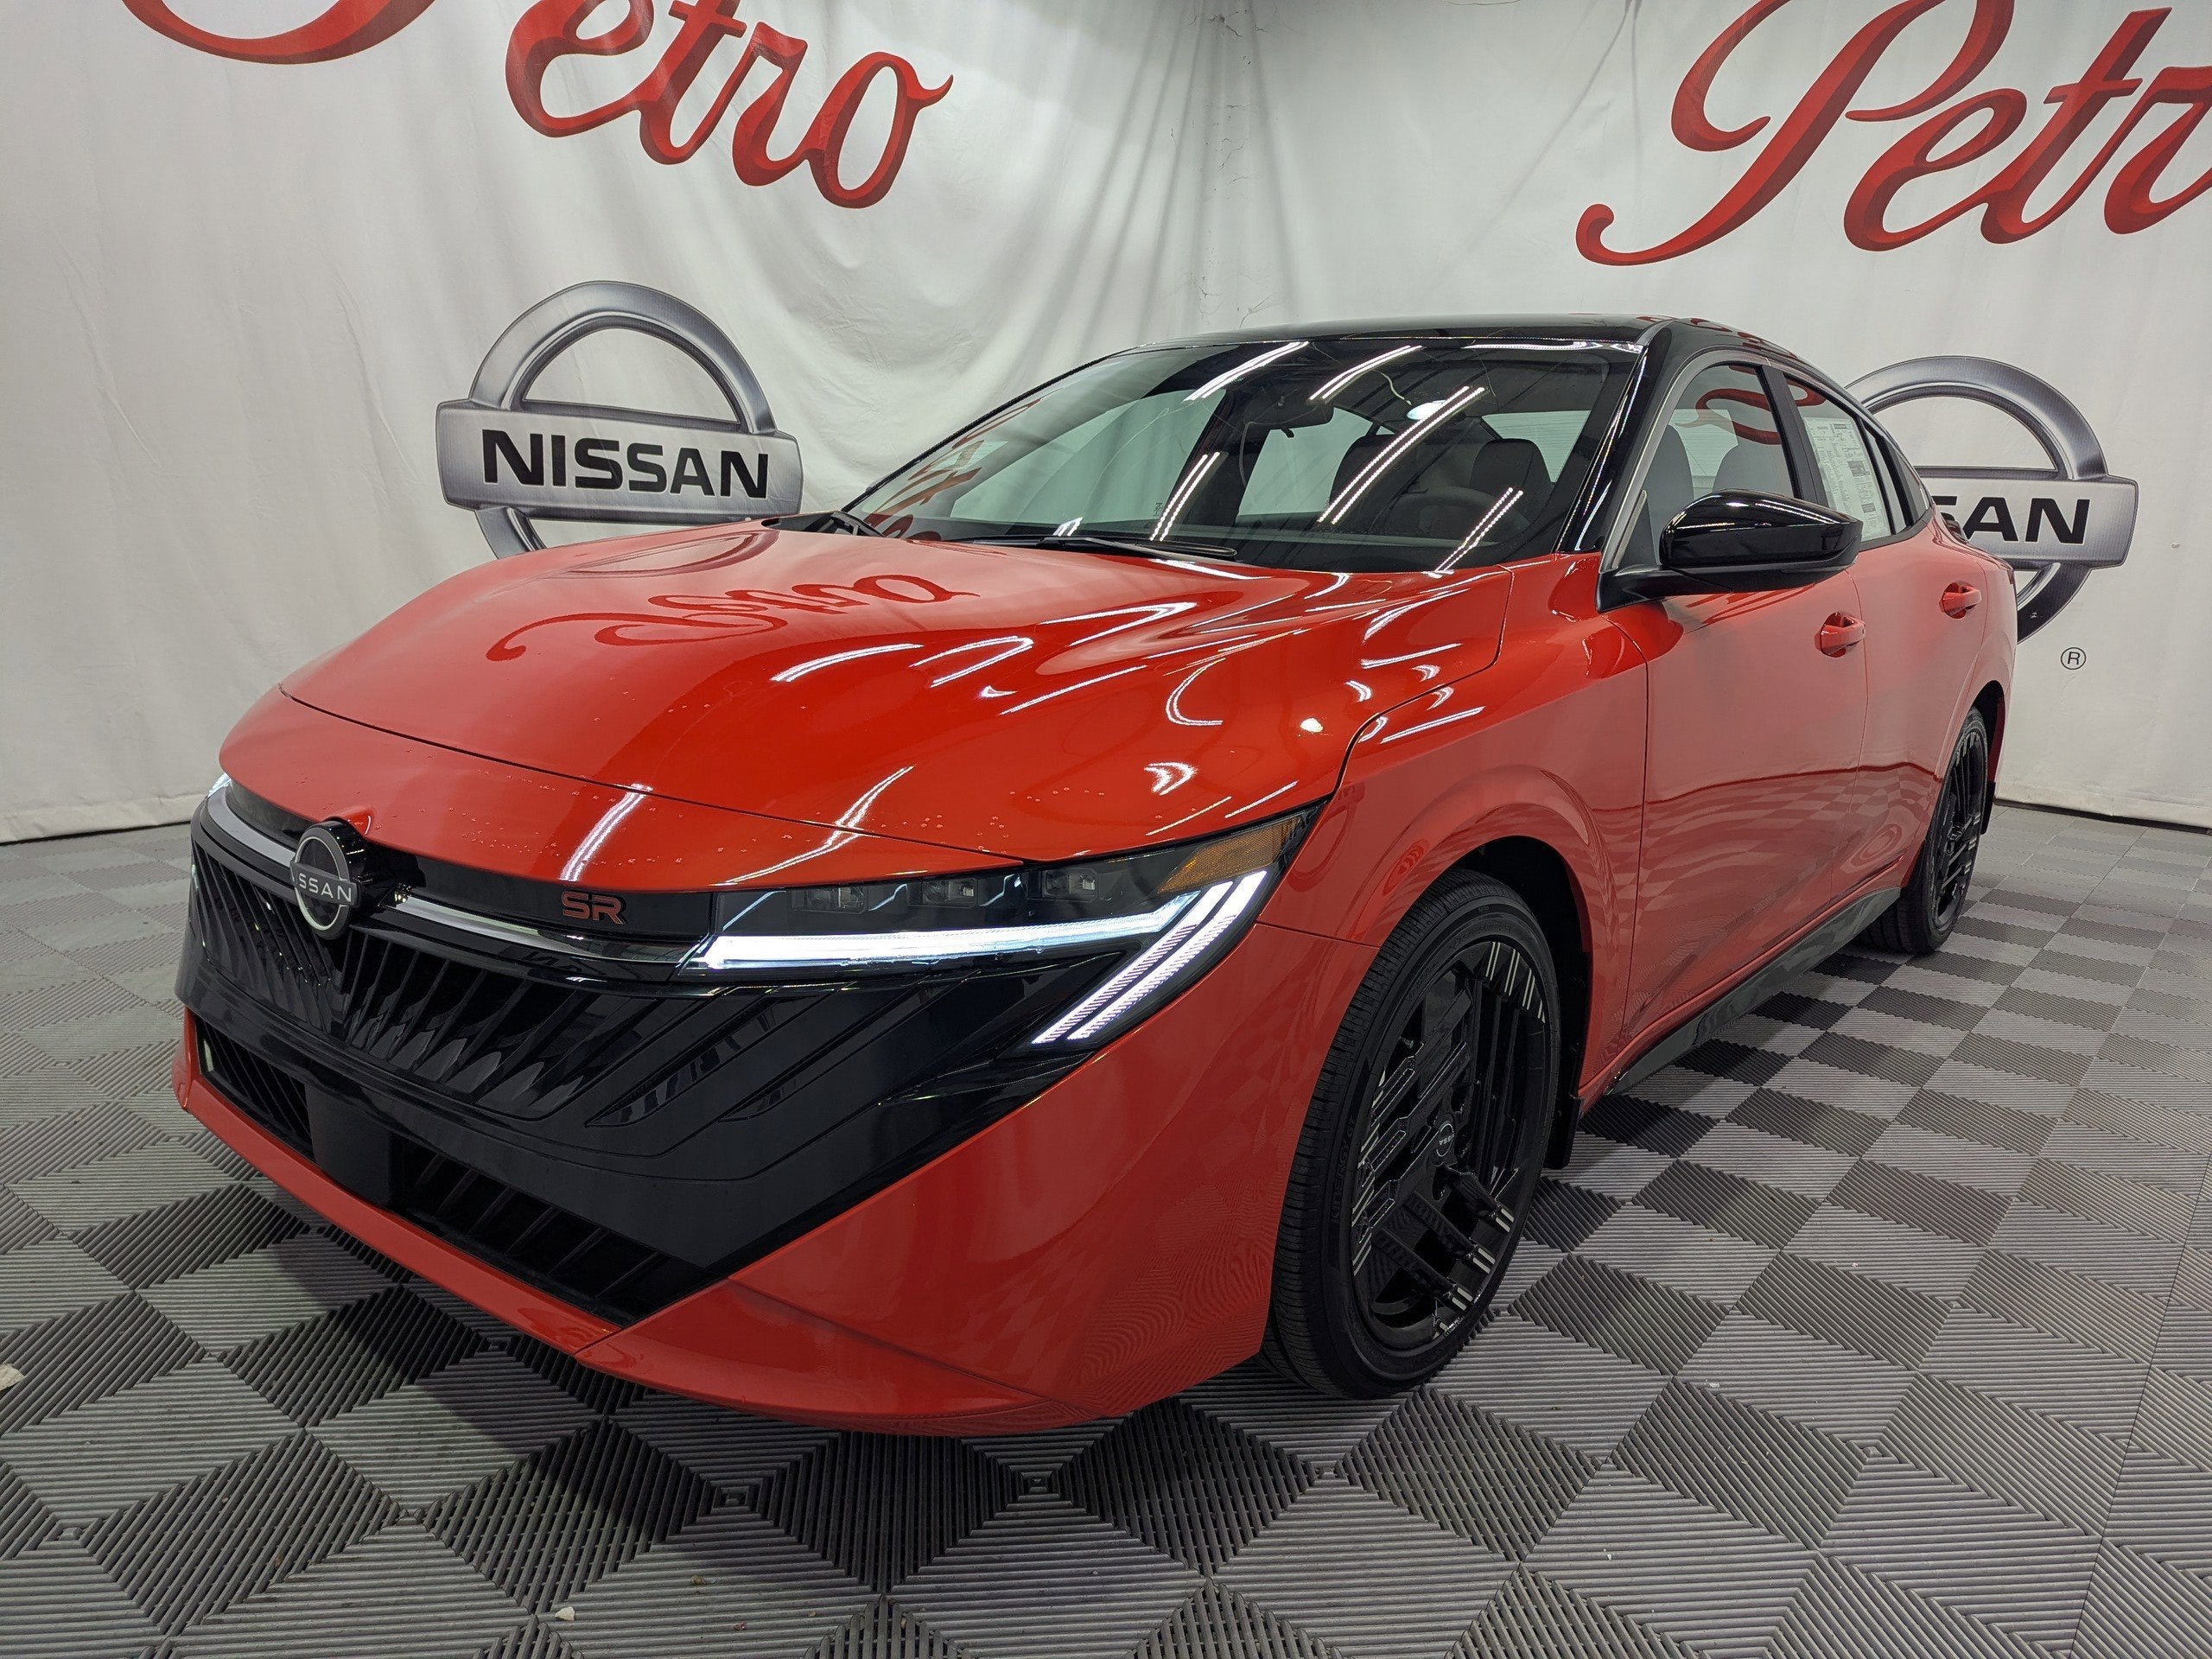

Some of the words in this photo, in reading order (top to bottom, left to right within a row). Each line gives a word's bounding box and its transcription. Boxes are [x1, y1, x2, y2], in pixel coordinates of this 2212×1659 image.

[482, 429, 768, 499] NISSAN
[296, 871, 352, 902] SSAN
[562, 891, 626, 925] SR
